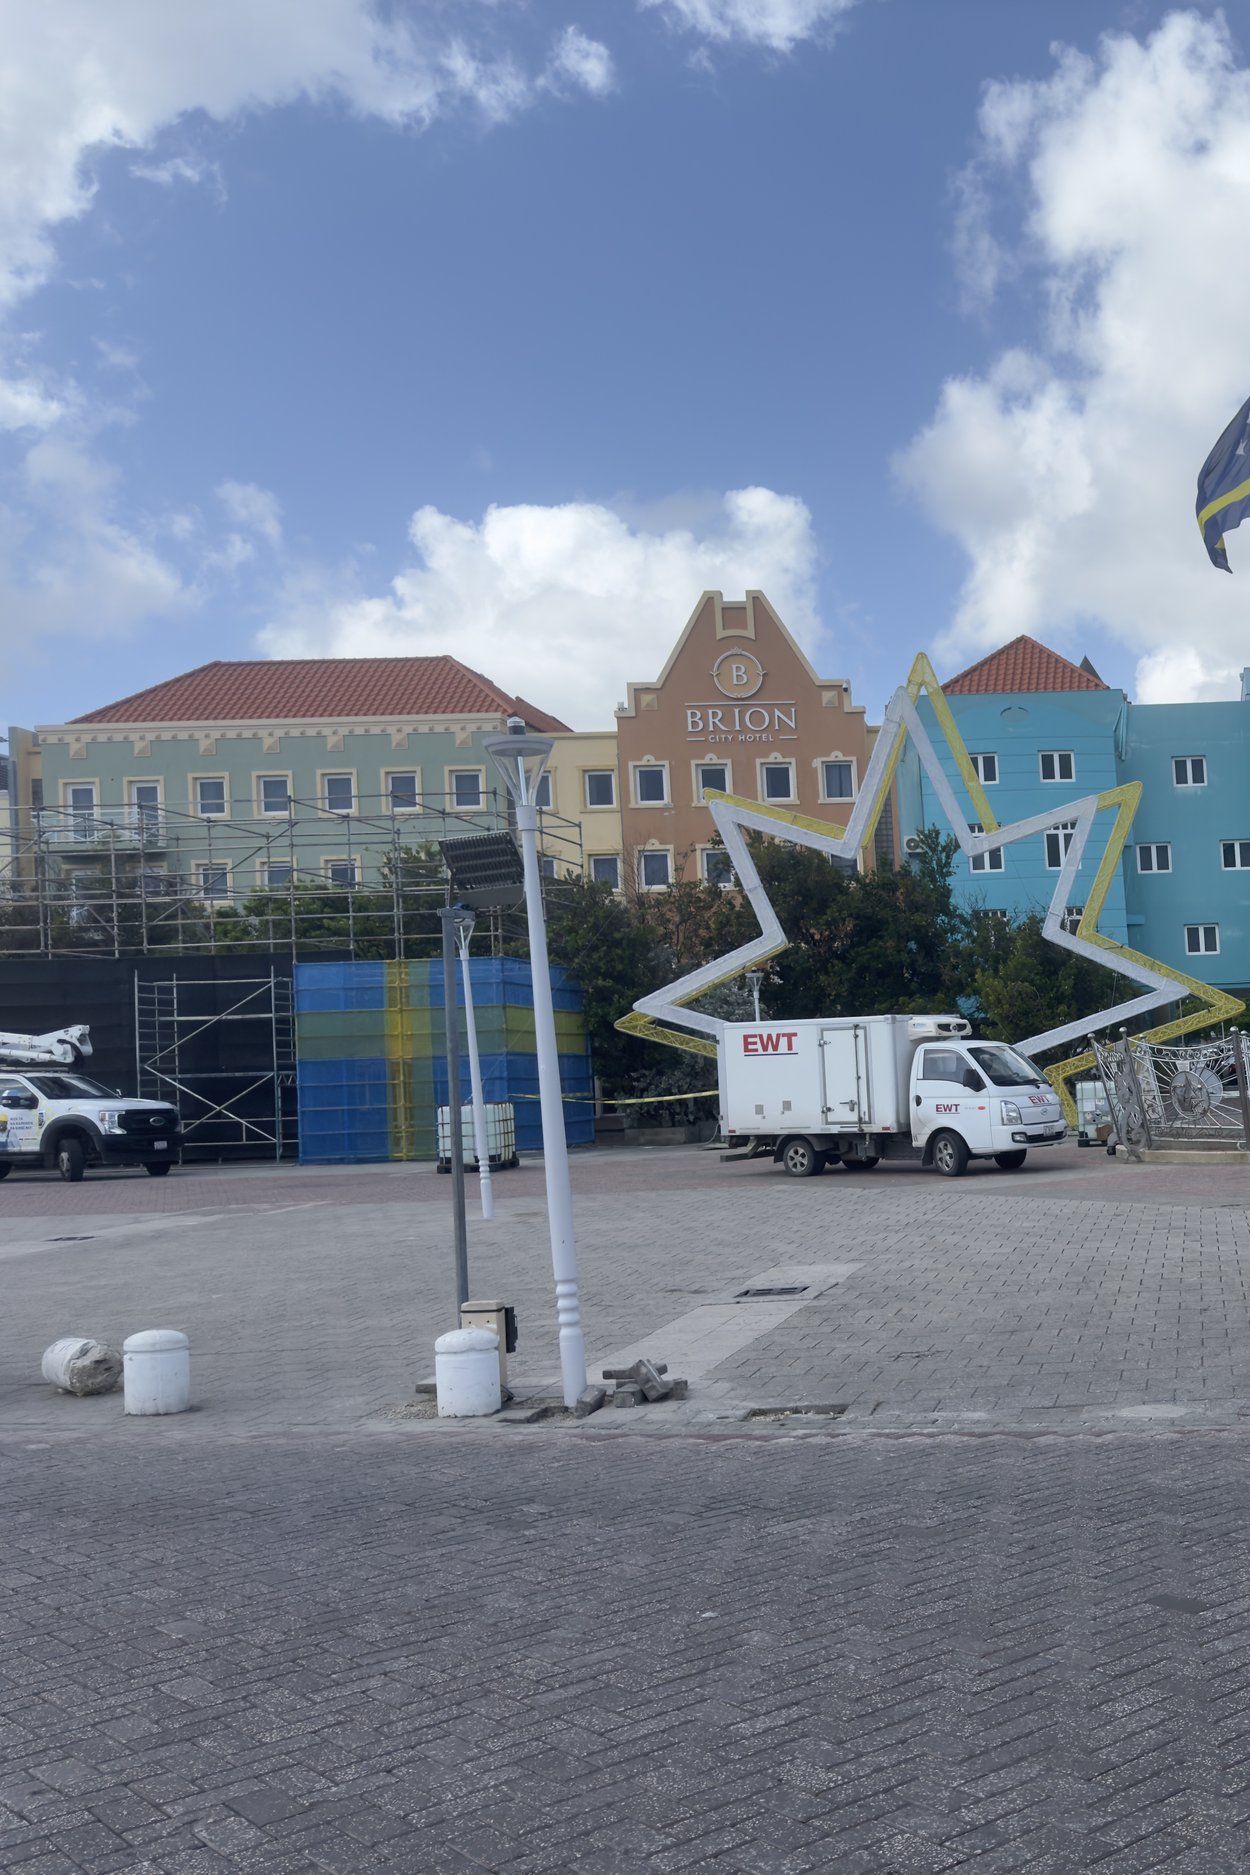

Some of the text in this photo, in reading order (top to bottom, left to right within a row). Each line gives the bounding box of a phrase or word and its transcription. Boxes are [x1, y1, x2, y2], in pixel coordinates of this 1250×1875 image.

[731, 664, 748, 685] B
[686, 707, 797, 732] BRION
[708, 733, 775, 743] CITY HOTEL
[742, 1032, 798, 1053] EWT
[1028, 1095, 1050, 1105] EWT
[935, 1103, 960, 1113] EWT
